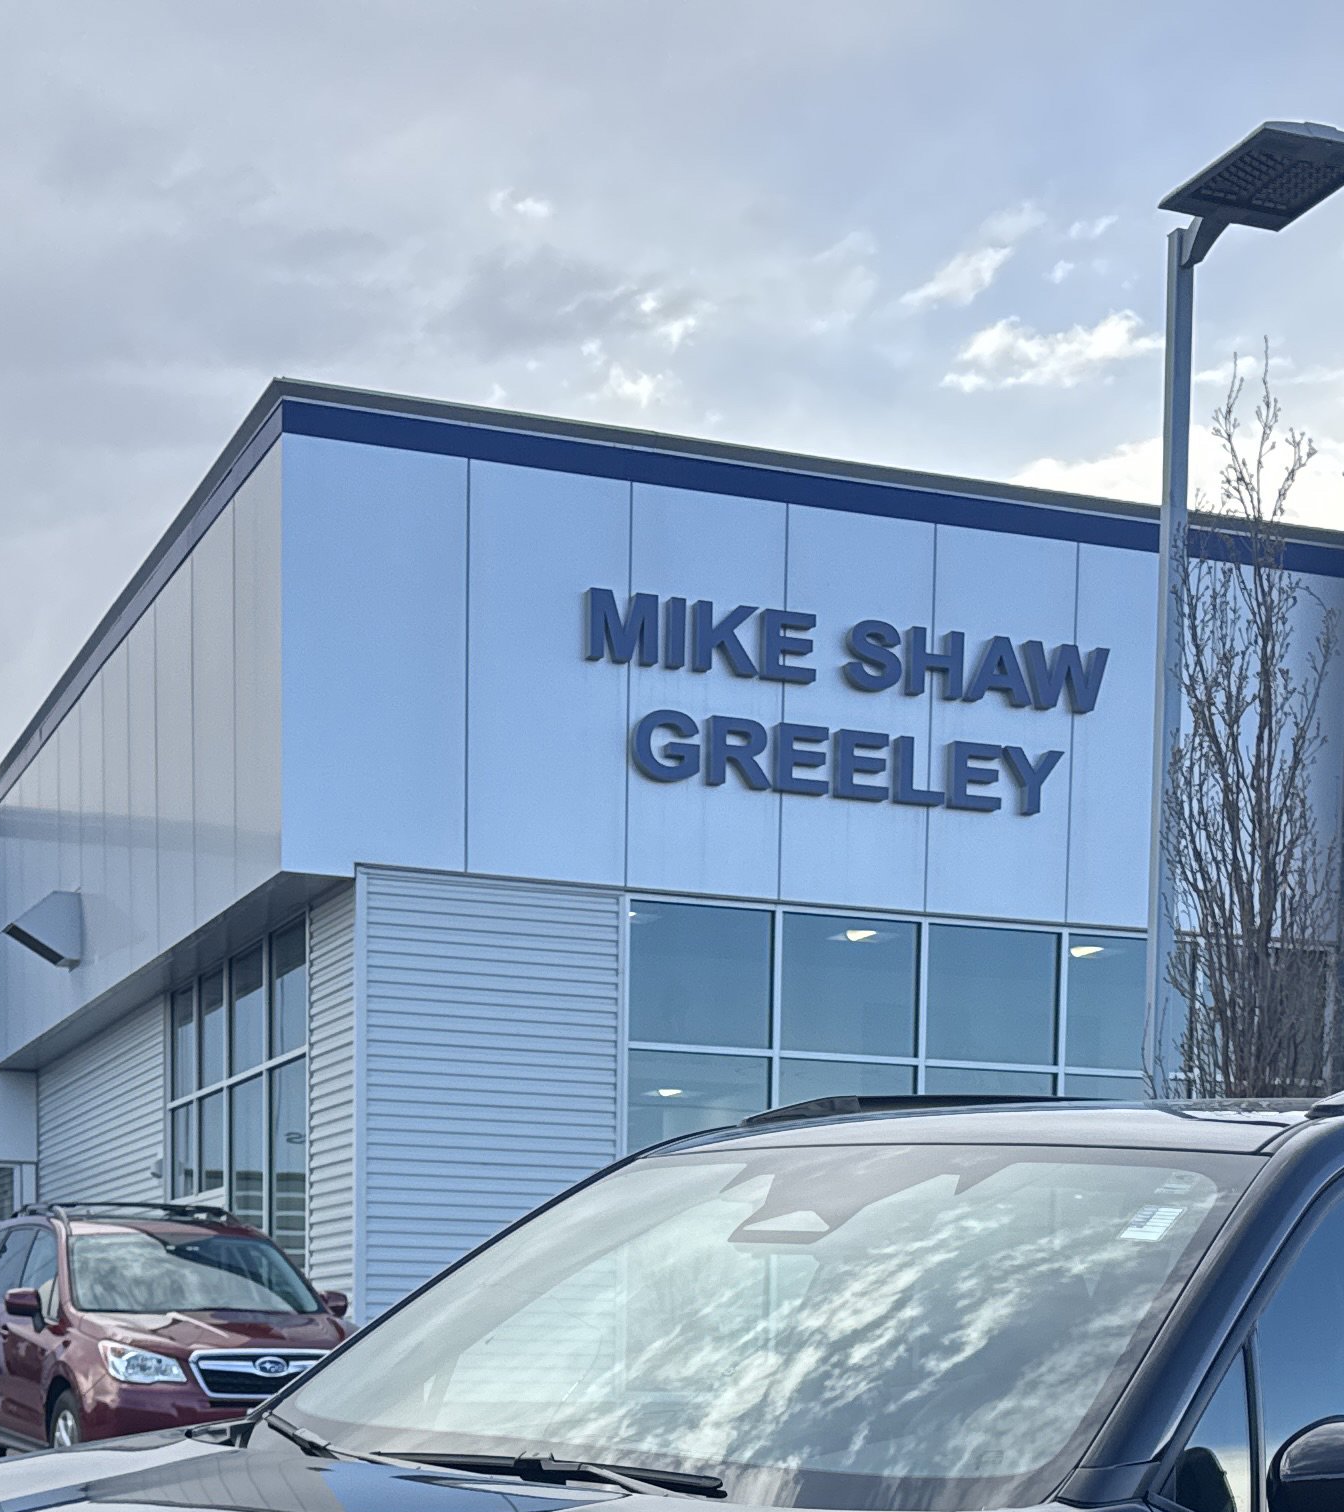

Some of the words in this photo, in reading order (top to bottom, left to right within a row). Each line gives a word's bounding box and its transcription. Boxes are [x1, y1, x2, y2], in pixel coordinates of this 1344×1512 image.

[584, 586, 817, 685] MIKE
[842, 619, 1111, 715] SHAW
[631, 709, 1066, 816] GREELEY
